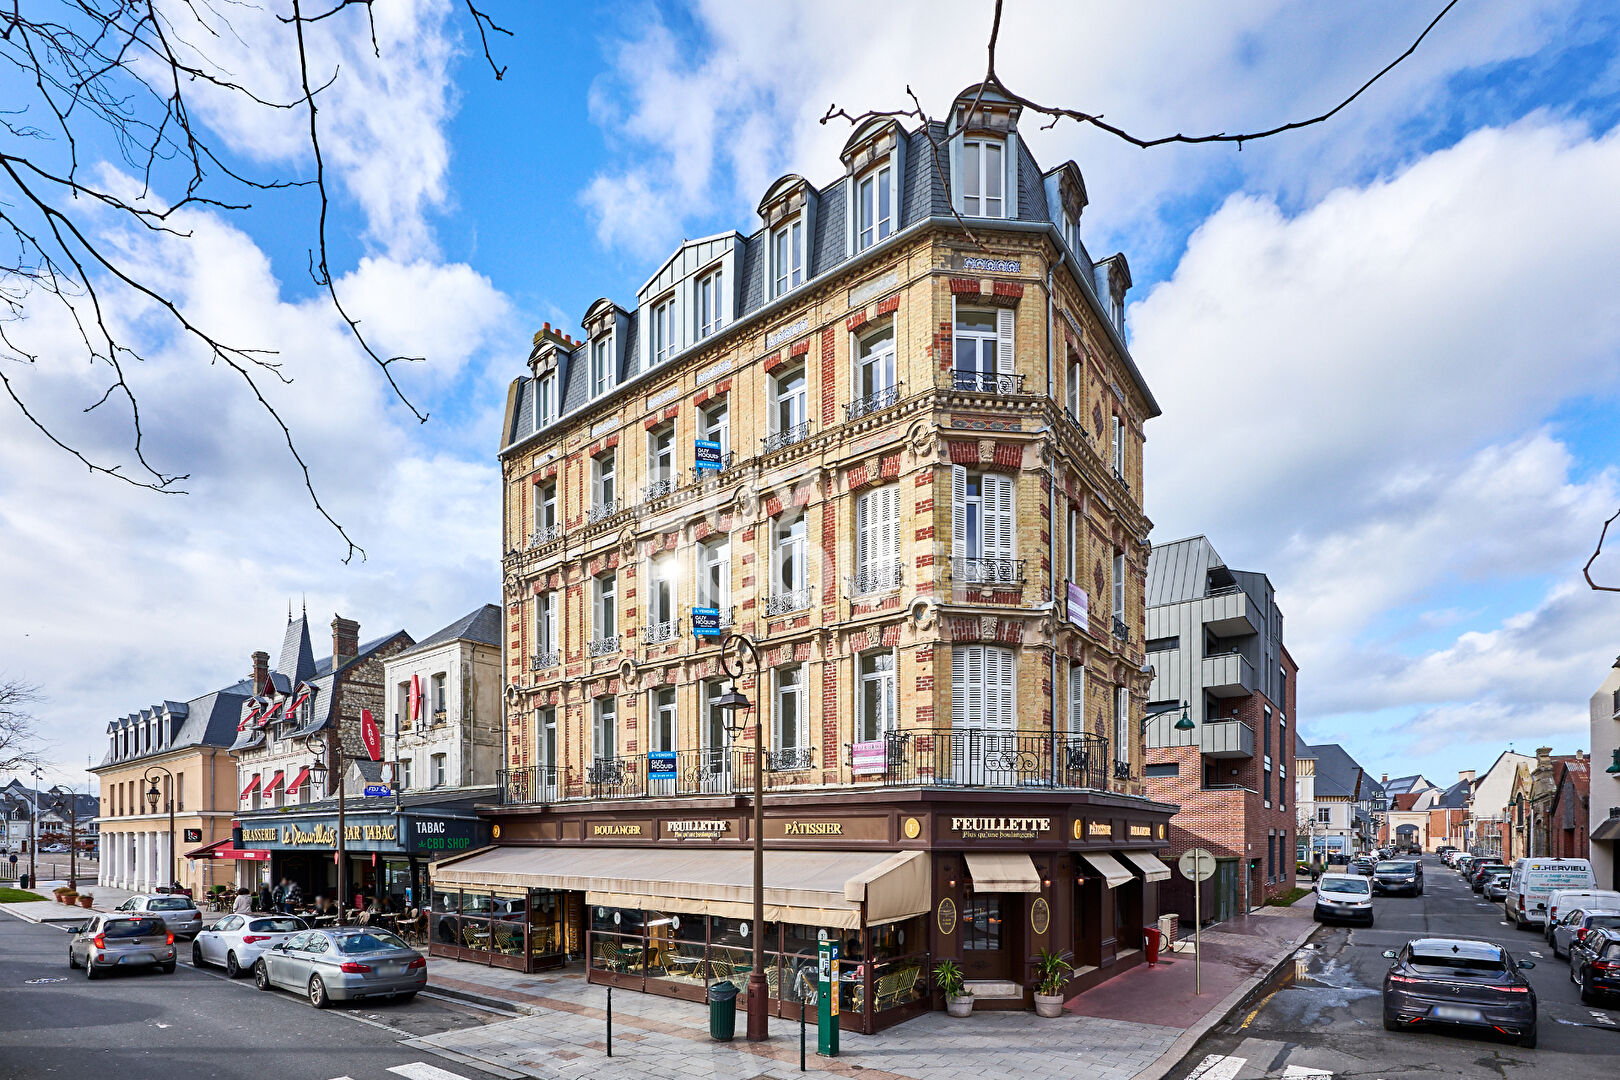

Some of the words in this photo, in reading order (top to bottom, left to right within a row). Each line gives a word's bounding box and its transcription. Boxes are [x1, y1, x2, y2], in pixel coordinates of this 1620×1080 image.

[366, 723, 376, 746] TABAC
[416, 821, 446, 834] TABAC
[594, 825, 642, 835] BOULANGER
[667, 820, 727, 832] FEUILLETTE
[785, 820, 843, 835] PÂTISSIER
[952, 817, 1050, 831] FEUILLETTE
[242, 827, 277, 842] BRASSERIE
[363, 824, 396, 841] TABAC
[427, 837, 445, 849] CBD
[447, 837, 470, 849] SHOP
[832, 948, 838, 958] P
